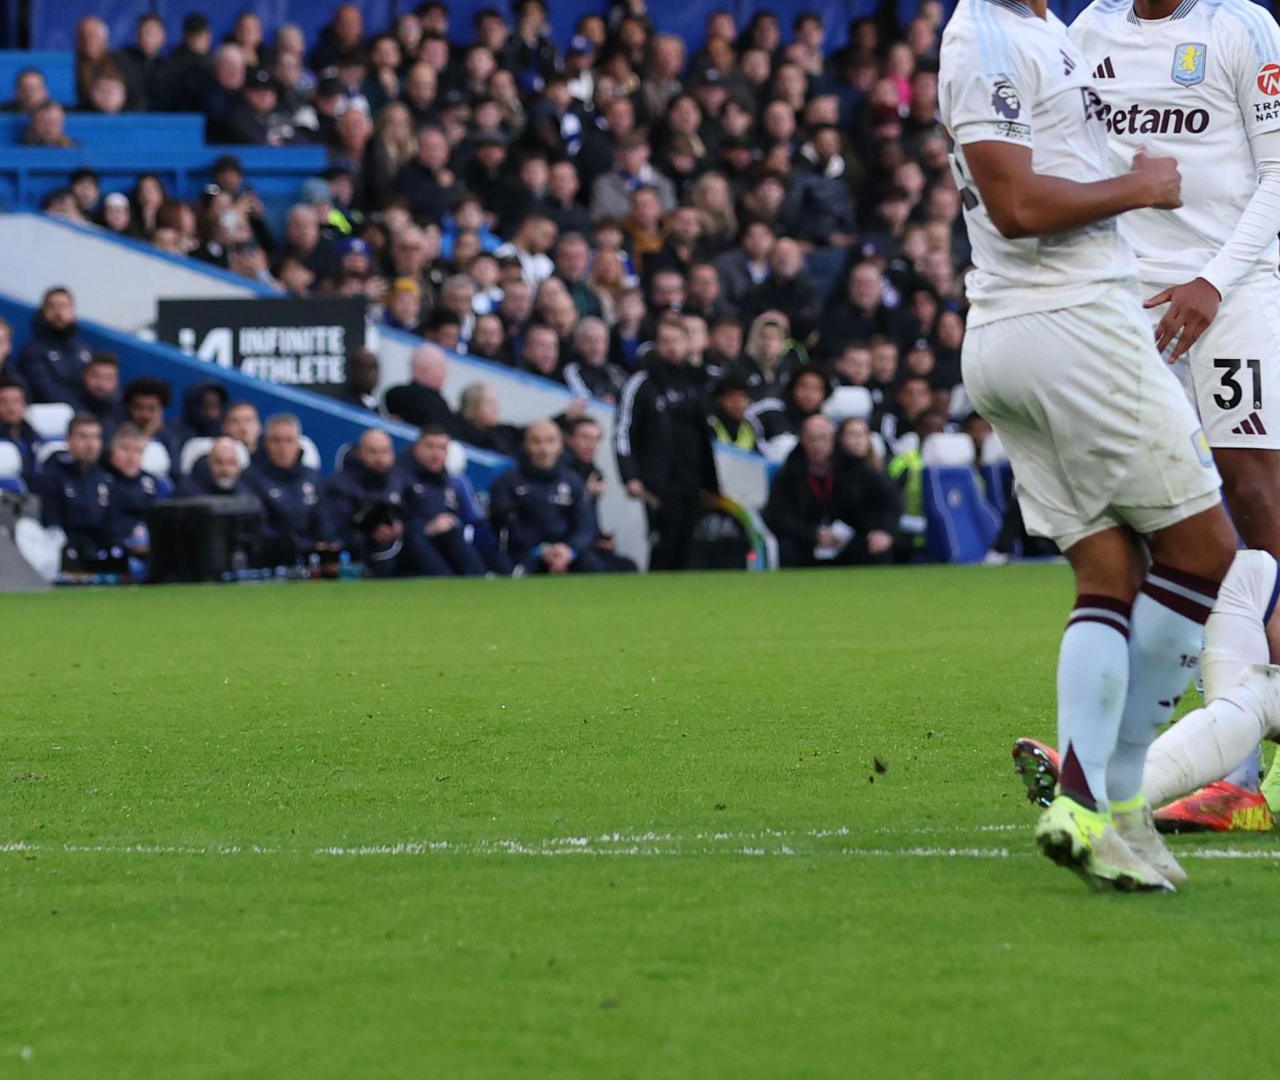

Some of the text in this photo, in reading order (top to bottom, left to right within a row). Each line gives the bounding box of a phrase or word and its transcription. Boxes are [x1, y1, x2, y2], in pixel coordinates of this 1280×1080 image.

[239, 325, 346, 356] INFINITE
[240, 355, 346, 384] ATHLETE
[1212, 358, 1263, 410] 31
